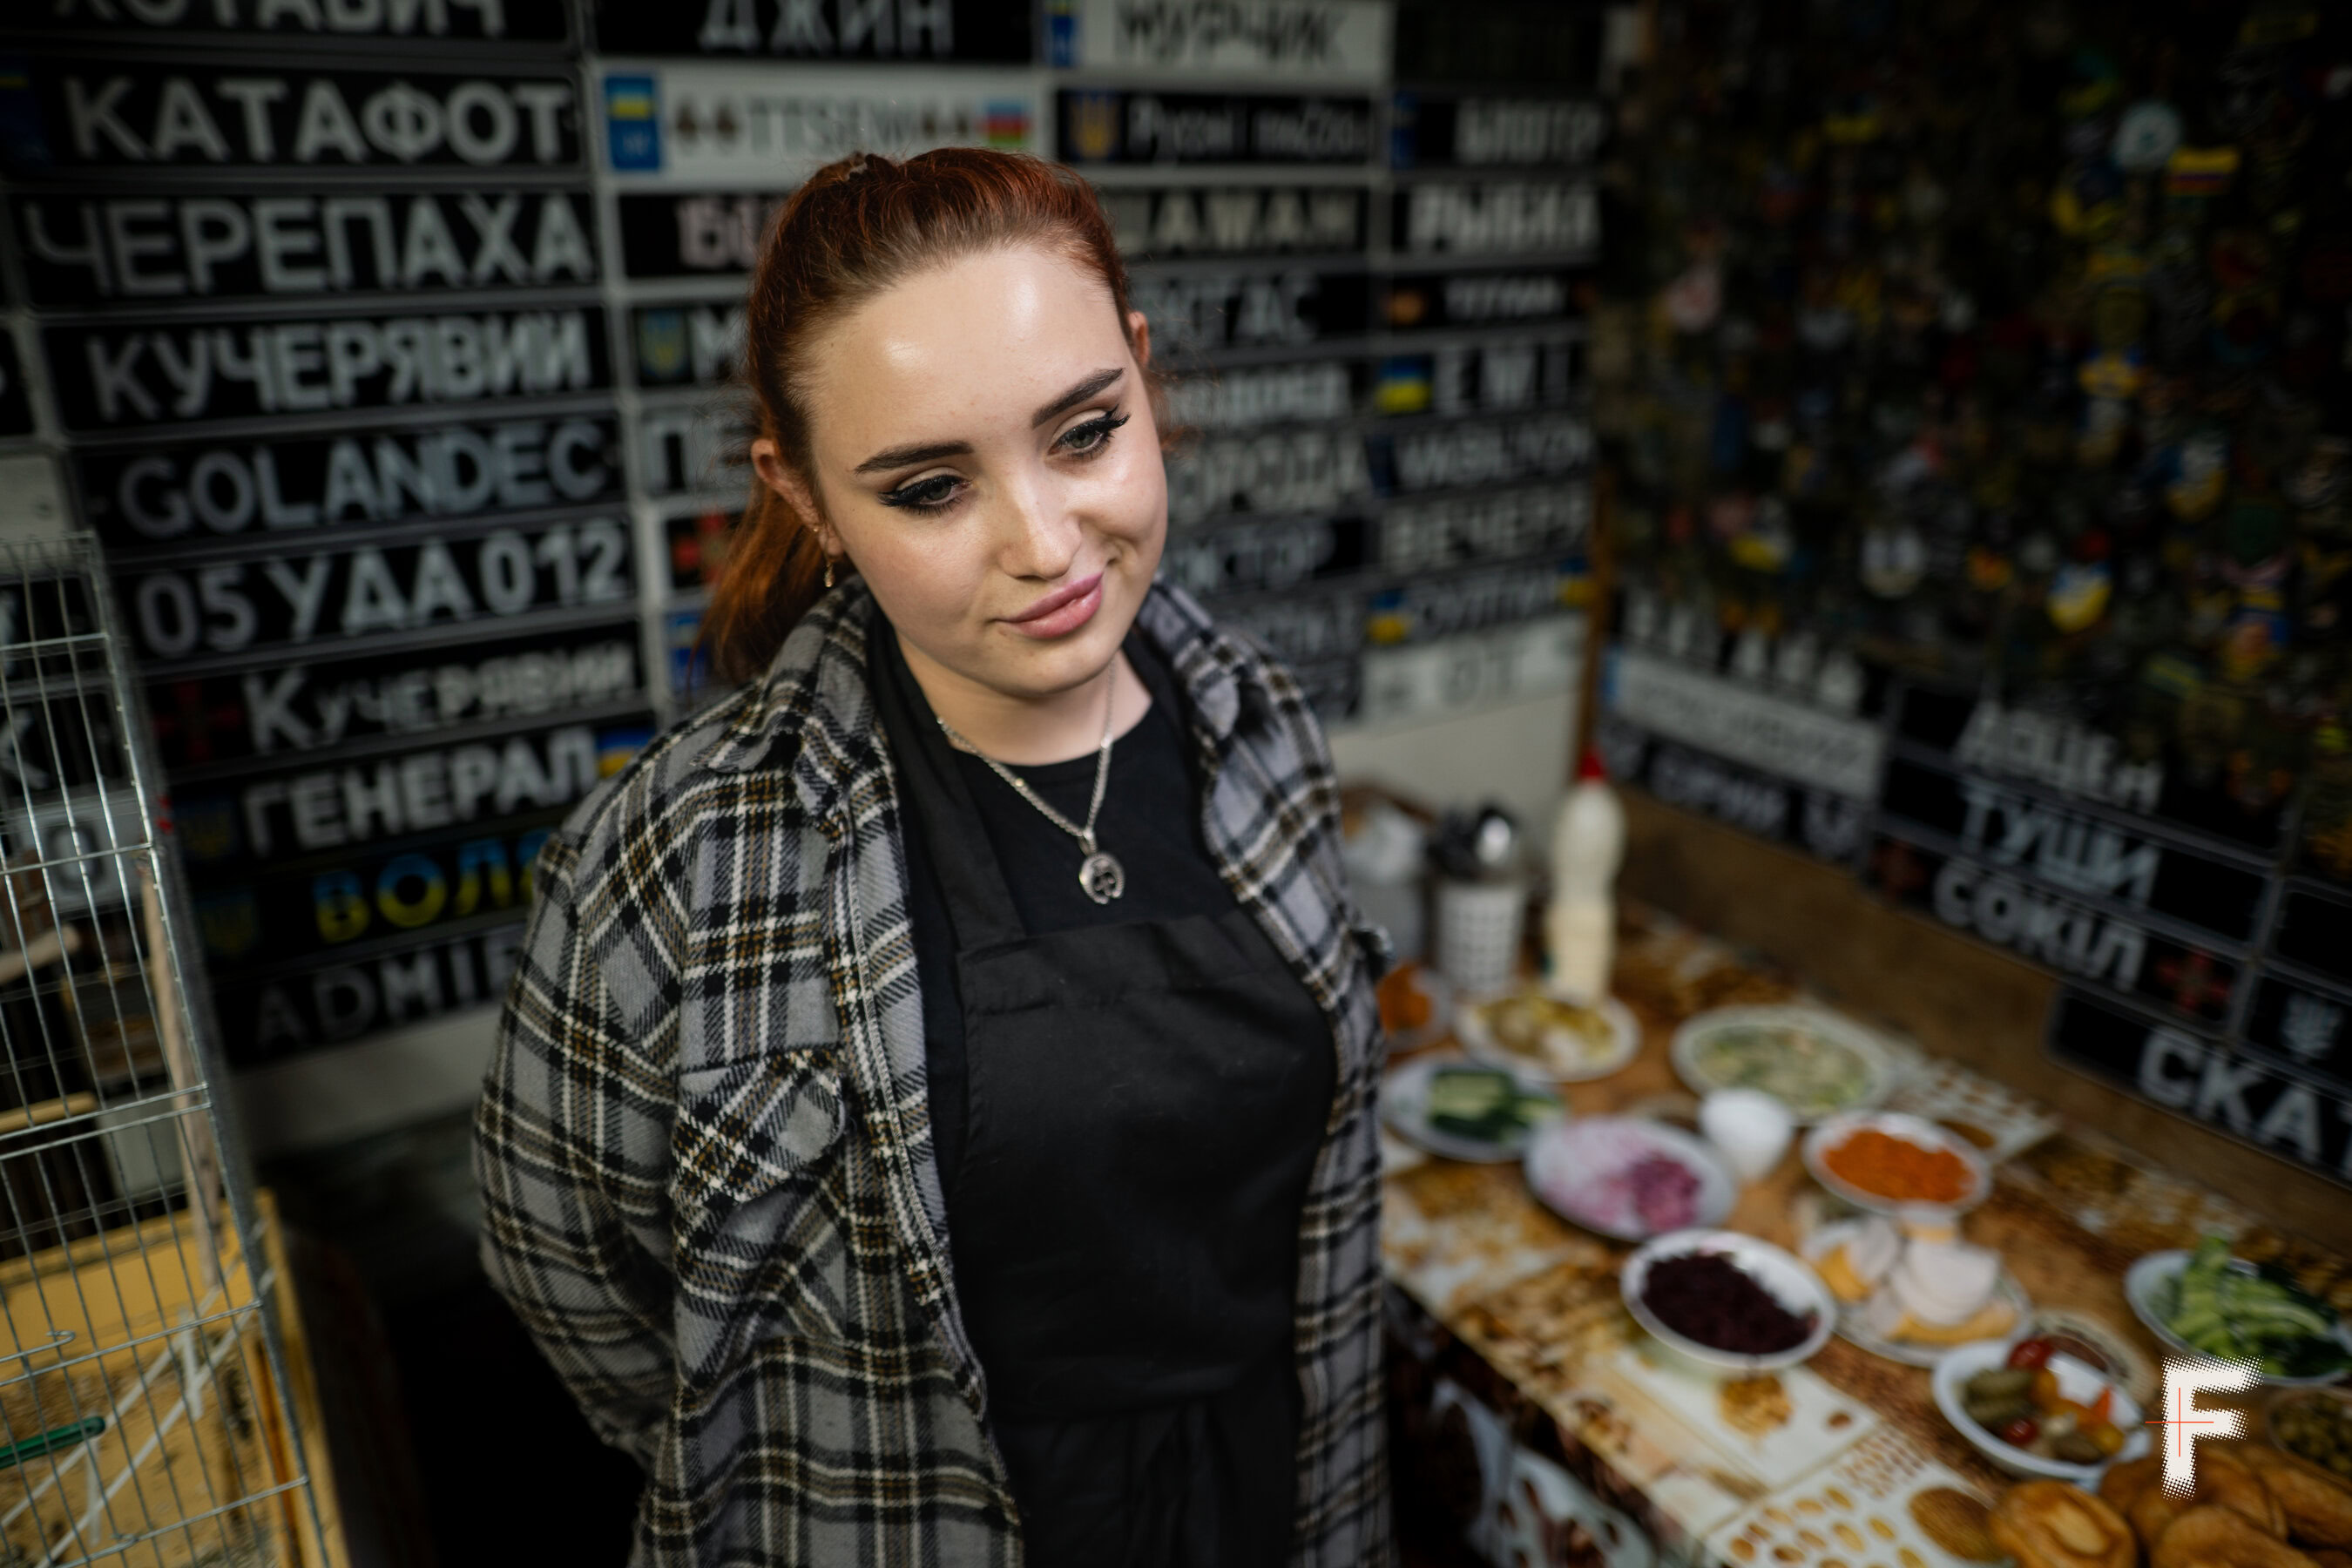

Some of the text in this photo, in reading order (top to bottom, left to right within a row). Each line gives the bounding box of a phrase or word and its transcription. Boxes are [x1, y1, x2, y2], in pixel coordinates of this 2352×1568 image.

[63, 76, 571, 165] КАТАФОТ
[23, 192, 596, 295] ЧЕРЕПАХА
[118, 417, 608, 534] GOLANDEC
[245, 727, 596, 856] ГЕНЕРАЛ
[1935, 859, 2146, 991] СОКІЛ
[2139, 1024, 2352, 1179] СКА
